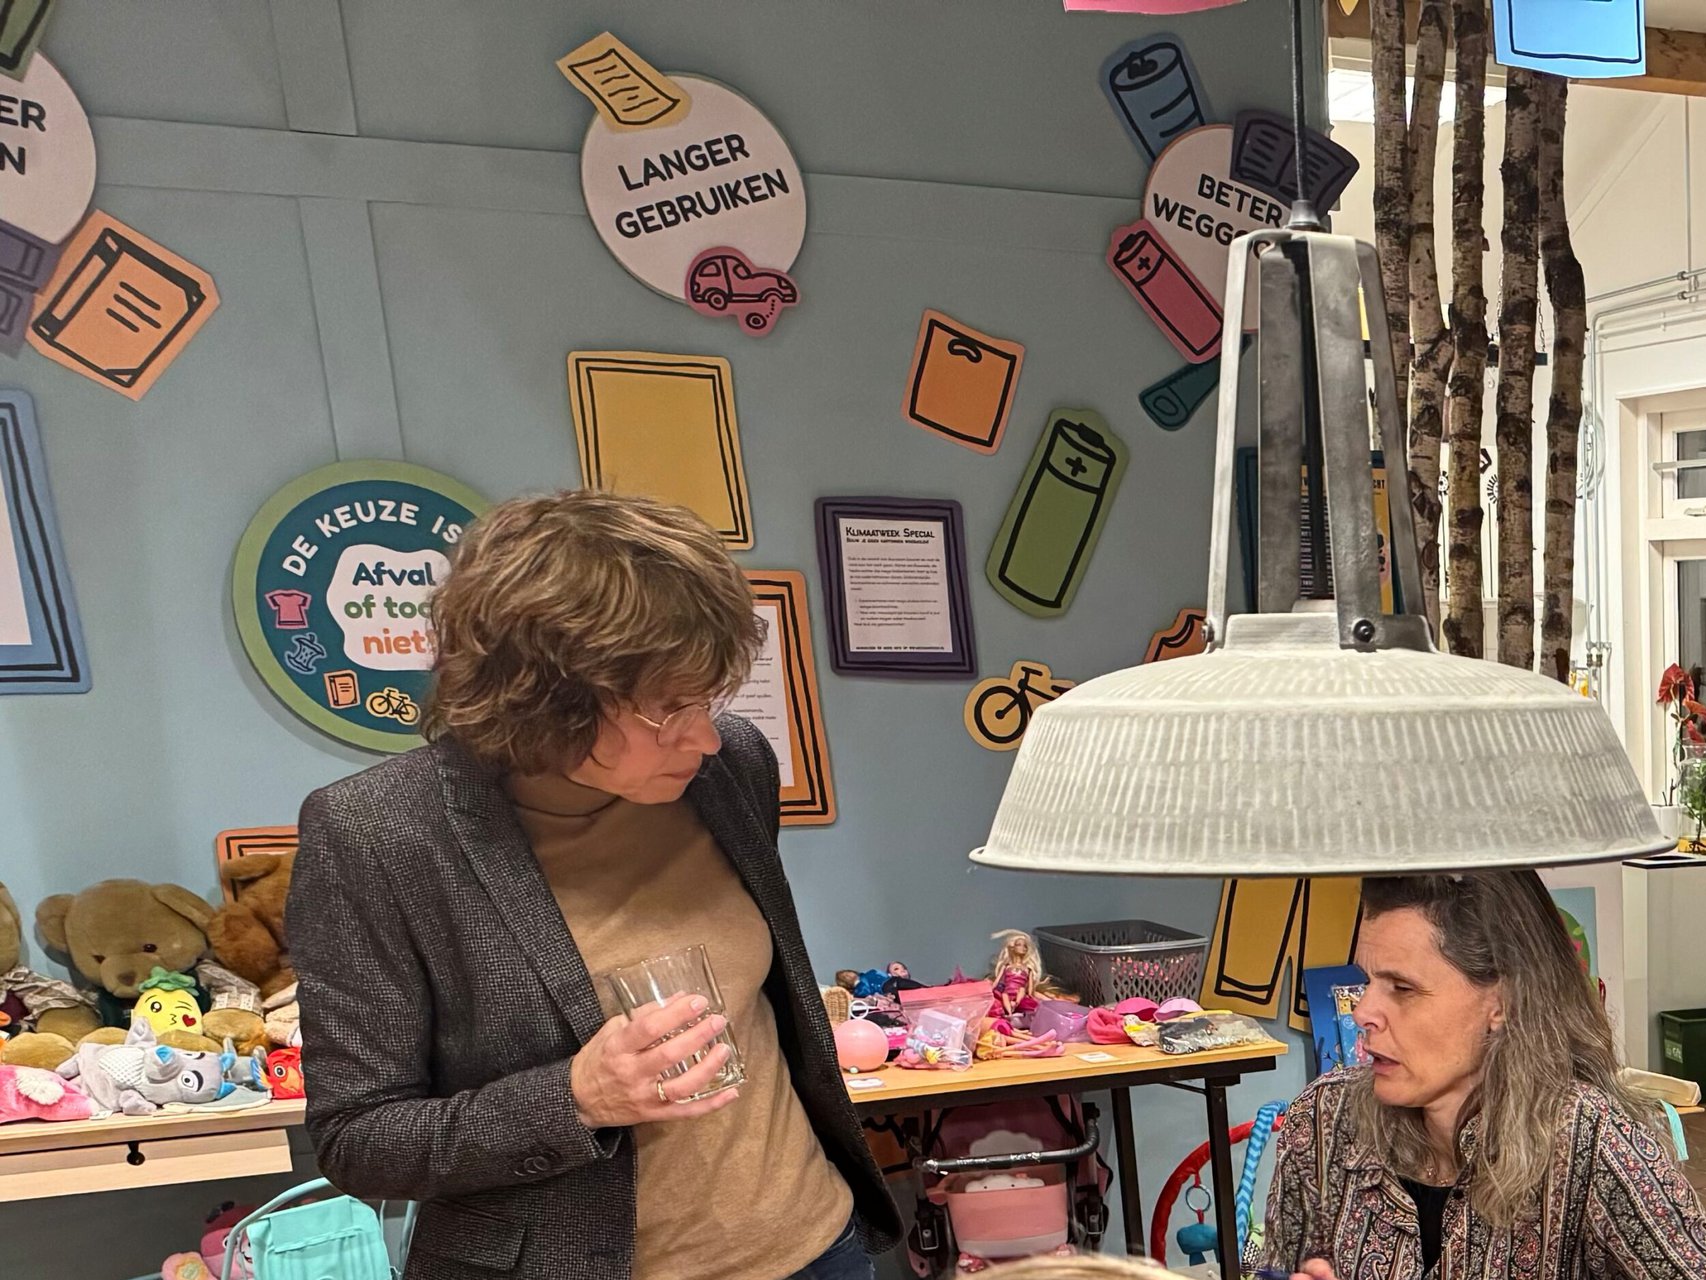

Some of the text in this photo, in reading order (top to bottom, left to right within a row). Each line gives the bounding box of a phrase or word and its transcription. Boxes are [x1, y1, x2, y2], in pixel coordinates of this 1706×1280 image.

[618, 134, 750, 191] LANGER
[616, 168, 790, 238] GEBRUIKEN
[1198, 173, 1283, 228] BETER
[282, 499, 464, 577] DE KEUZE IS
[352, 562, 437, 586] Afval
[344, 594, 432, 619] of toc
